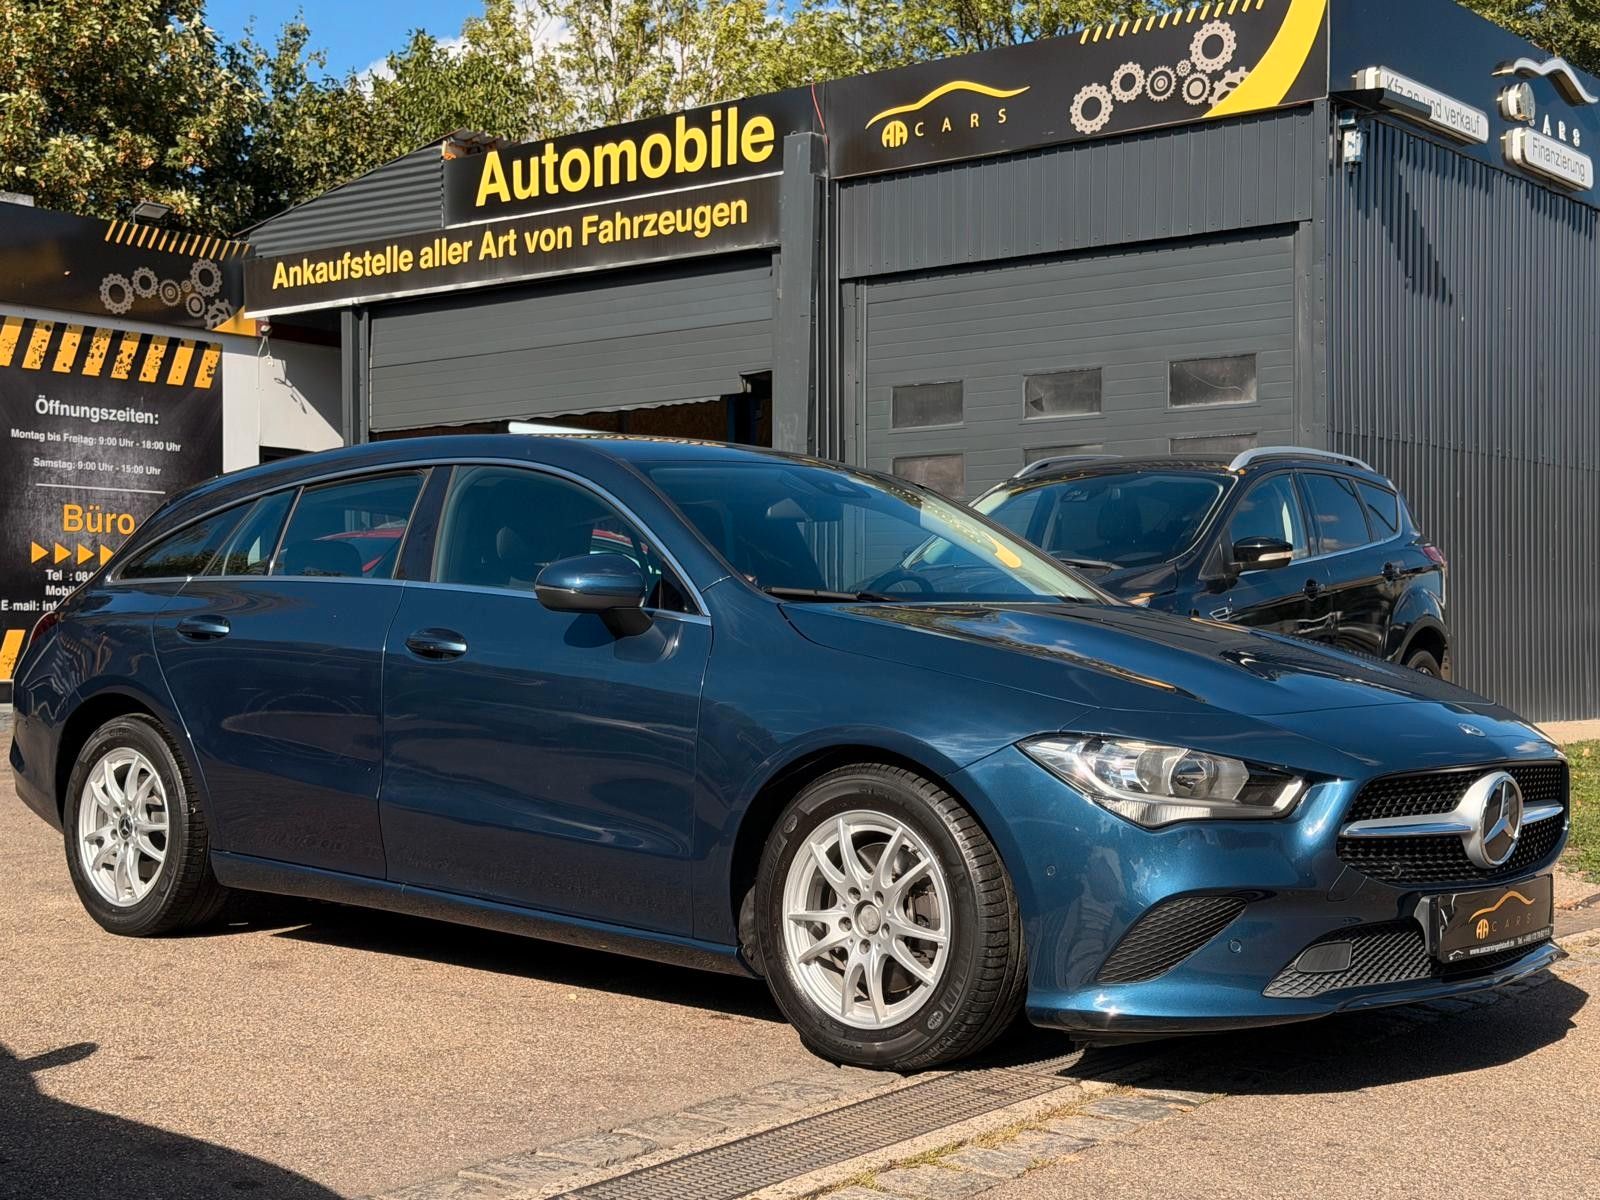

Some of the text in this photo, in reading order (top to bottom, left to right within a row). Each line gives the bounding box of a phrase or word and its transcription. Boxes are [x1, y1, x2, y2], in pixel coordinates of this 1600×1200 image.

[914, 108, 1007, 137] CARS
[1444, 105, 1480, 135] verkauf
[475, 106, 775, 207] Automobile
[1532, 136, 1585, 182] Finanzierung
[272, 199, 749, 289] Ankaufstelle aller Art von Fahrzeugen
[35, 394, 159, 425] Öffnungszeiten:
[11, 428, 46, 443] Montag
[48, 432, 61, 442] bis
[63, 433, 97, 447] Freitag:
[99, 436, 117, 446] 9:00
[119, 437, 134, 448] Uhr
[142, 440, 164, 451] 18:00
[166, 441, 181, 452] Uhr
[33, 457, 76, 470] Samstag:
[77, 460, 96, 471] 9:00
[98, 461, 114, 472] Uhr
[121, 463, 144, 475] 15:00
[146, 465, 161, 475] Uhr
[63, 503, 136, 535] Büro
[1, 600, 40, 611] E-mail:
